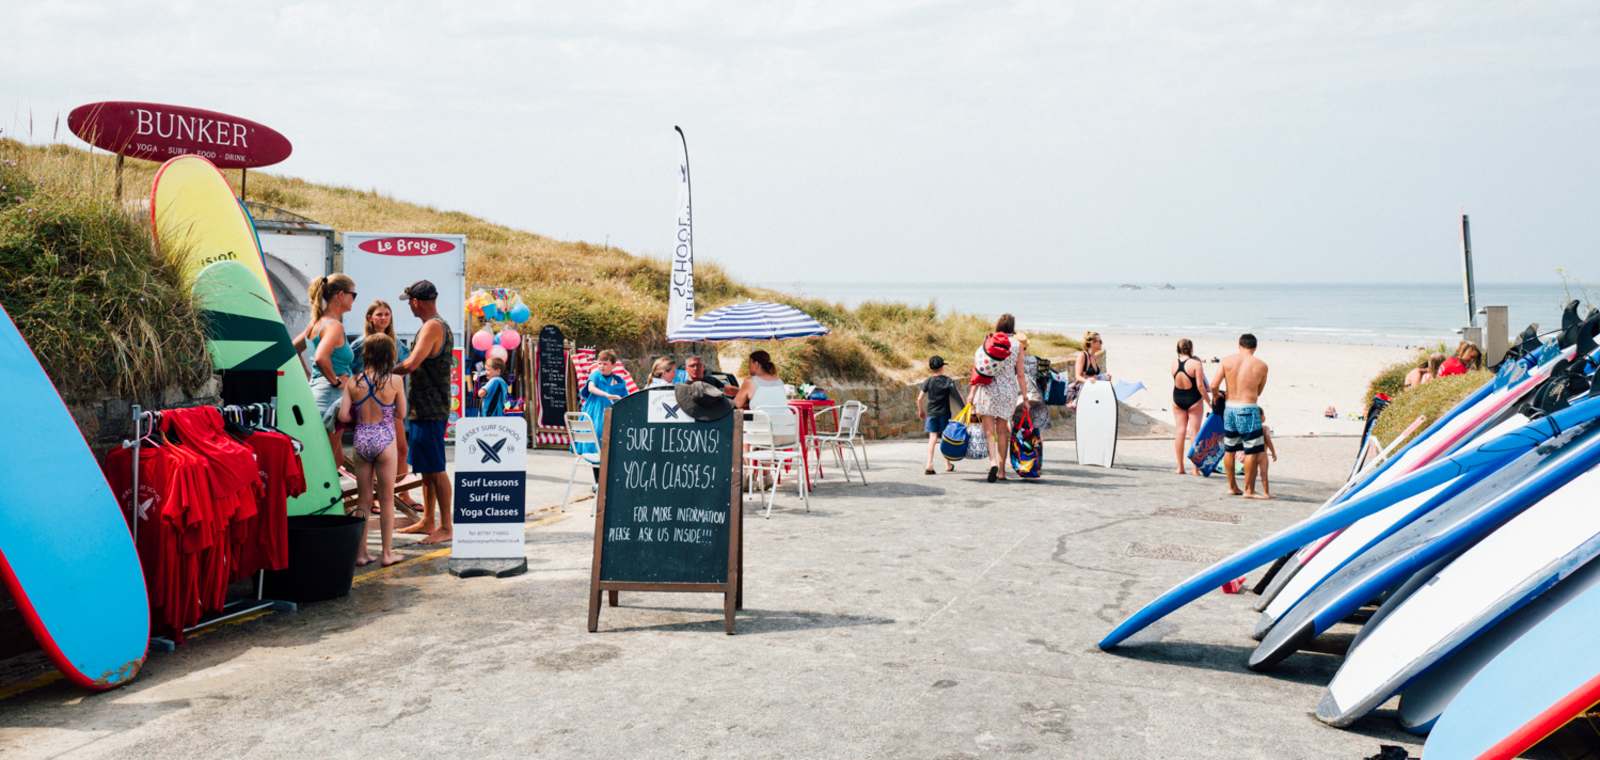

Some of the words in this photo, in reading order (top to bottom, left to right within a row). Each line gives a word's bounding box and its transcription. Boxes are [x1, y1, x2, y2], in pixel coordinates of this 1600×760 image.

[136, 109, 248, 148] BUNKER
[136, 143, 158, 152] YOGA
[168, 147, 188, 156] SURF
[197, 150, 217, 159] FOOD
[224, 153, 246, 161] DRINK
[377, 240, 393, 253] Le
[397, 239, 438, 255] Braye
[461, 427, 480, 444] JERSEY
[497, 424, 521, 443] SCHOOL
[626, 427, 655, 452] SURF
[661, 427, 720, 454] LESSONS!
[461, 478, 481, 487] Surf
[482, 478, 519, 487] Lessons
[623, 461, 657, 491] YOGA
[661, 461, 716, 490] CLASSES!
[469, 492, 489, 502] Surf
[490, 493, 510, 502] Hire
[460, 508, 483, 519] Yoga
[484, 507, 519, 516] Classes
[633, 506, 648, 522] FOR
[651, 506, 672, 522] MORE
[676, 507, 726, 524] INFORMATION
[608, 527, 631, 542] PLEASE
[638, 527, 653, 542] ASK
[657, 527, 669, 542] US
[673, 527, 712, 544] INSIDE!!!
